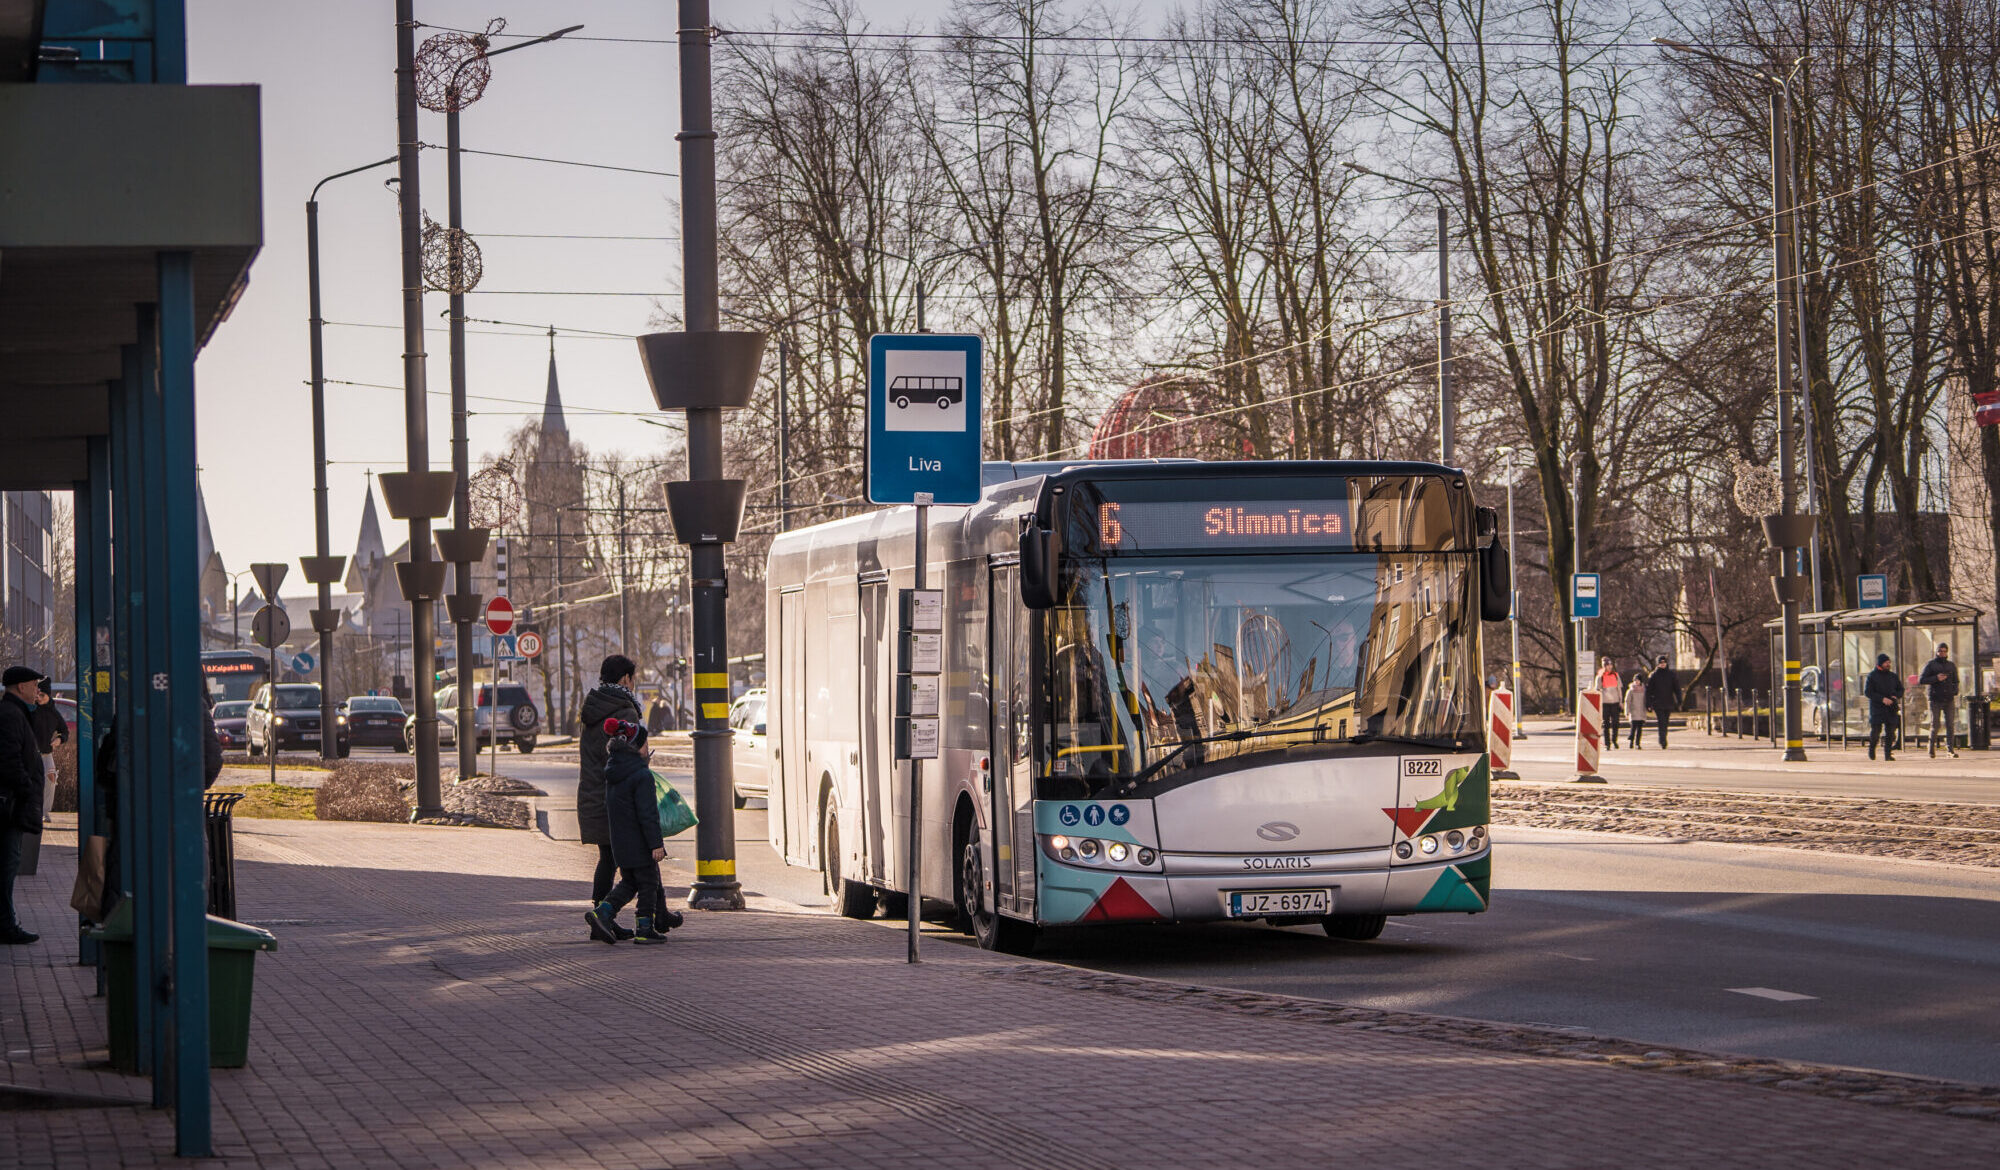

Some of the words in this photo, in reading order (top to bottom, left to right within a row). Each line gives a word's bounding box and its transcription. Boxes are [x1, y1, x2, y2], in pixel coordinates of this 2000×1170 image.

[1101, 502, 1121, 544] 6
[1205, 507, 1341, 535] Slimnīca
[524, 639, 536, 651] 30
[1408, 761, 1438, 774] 8222
[1243, 857, 1311, 869] SOLARIS
[1246, 894, 1322, 911] JZ-6974
